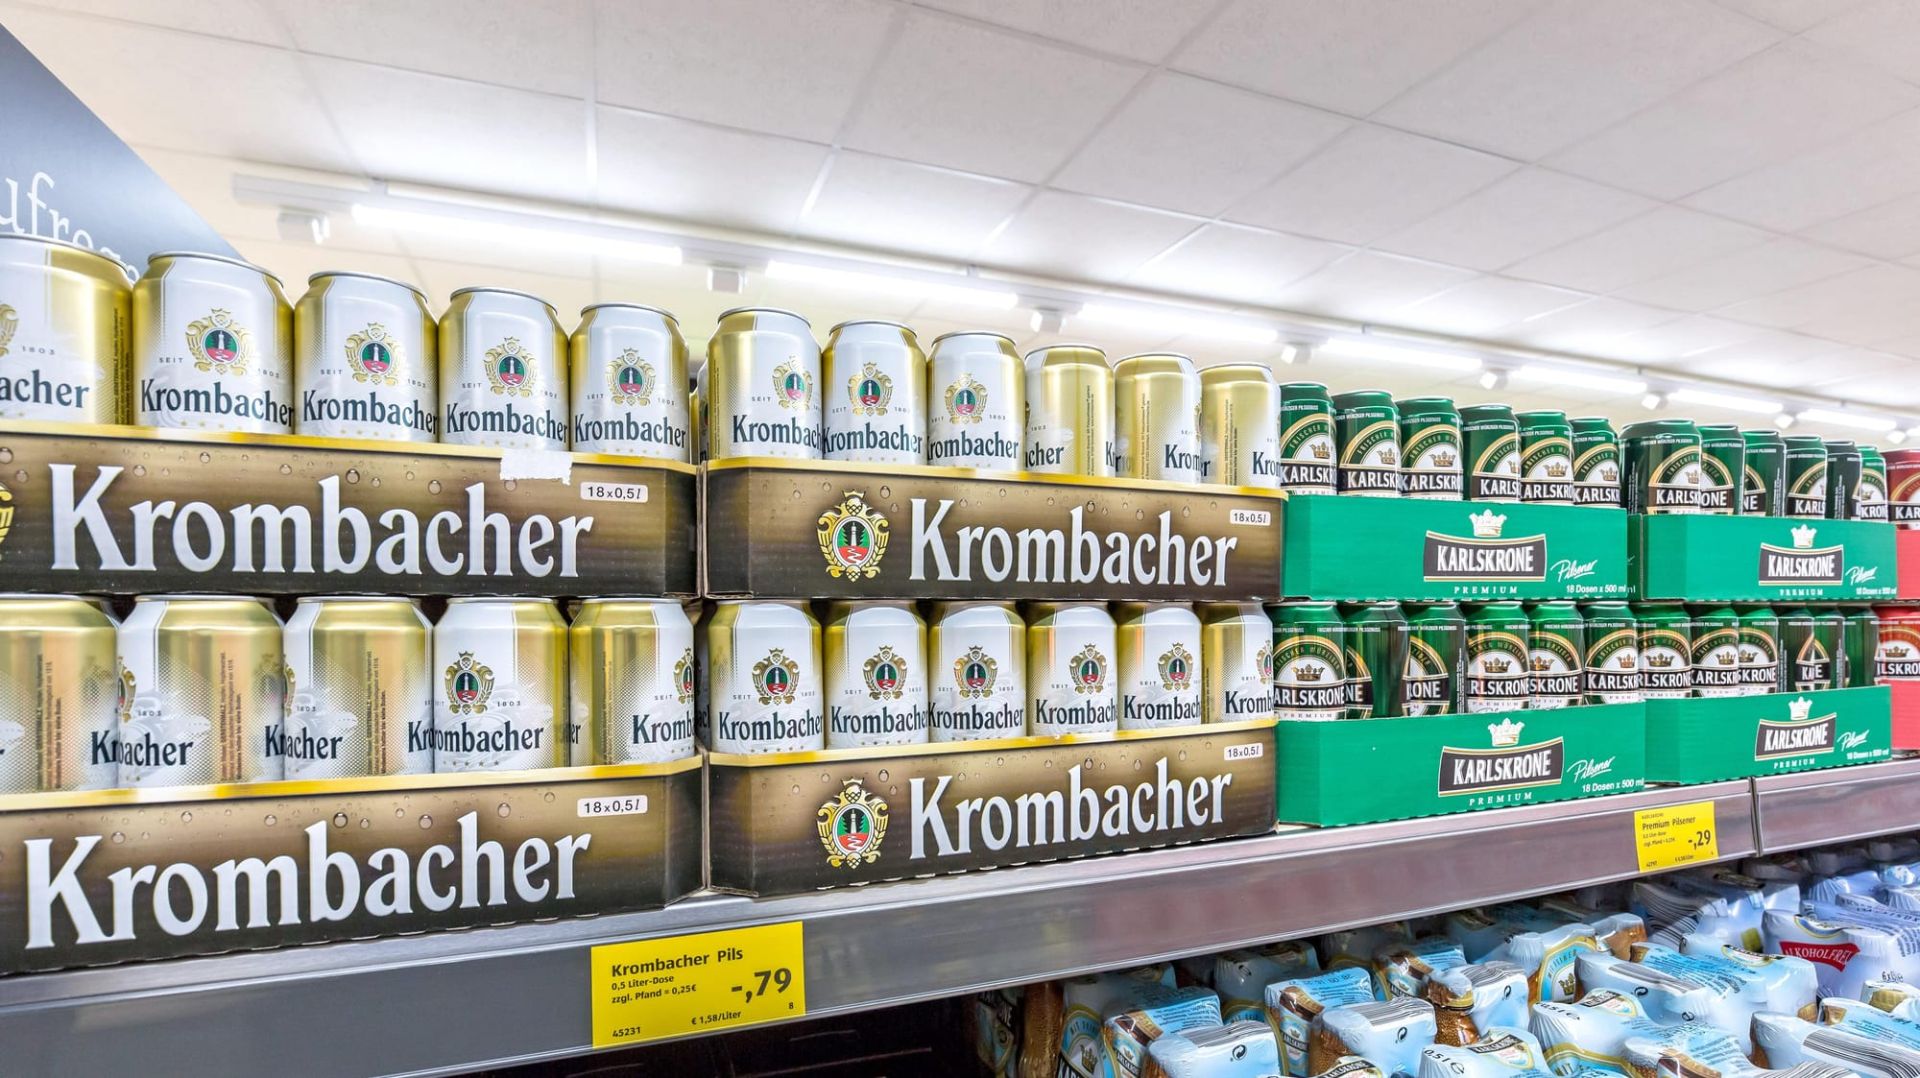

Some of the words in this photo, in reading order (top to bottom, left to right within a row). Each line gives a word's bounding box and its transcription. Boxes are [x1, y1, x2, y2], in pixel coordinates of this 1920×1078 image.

[22, 345, 56, 356] 1803
[140, 378, 294, 428] Krombacher
[303, 390, 439, 435] Krombacher
[831, 406, 847, 414] SEIT
[446, 403, 568, 443] Krombacher
[574, 412, 687, 449] Krombacher
[823, 422, 923, 455] Krombacher
[49, 463, 594, 578] Krombacher
[910, 497, 1239, 587] Krombacher
[1436, 544, 1534, 573] KARLSKRONE
[1768, 555, 1835, 577] KARLSKRONE
[1550, 559, 1598, 583] Pilsener
[1454, 586, 1519, 594] PREMIUM
[1566, 585, 1574, 594] 18
[1780, 588, 1823, 596] PREMIUM
[137, 708, 162, 717] 1803
[296, 705, 317, 713] 1803
[928, 699, 1024, 730] Krombacher
[1764, 723, 1829, 752] KARLSKRONE
[1453, 749, 1552, 785] KARLSKRONE
[1566, 755, 1616, 783] Pilsener
[1773, 758, 1816, 770] PREMIUM
[1582, 784, 1591, 793] 18
[1592, 782, 1614, 792] Dosen
[1622, 779, 1634, 788] 500
[910, 758, 1232, 860] Krombacher
[1468, 791, 1533, 806] PREMIUM
[1642, 820, 1670, 830] Premium
[1672, 816, 1696, 827] Pilsener
[23, 811, 592, 950] Krombacher
[611, 953, 710, 977] Krombacher
[717, 947, 744, 963] Pils
[611, 982, 626, 991] 0,5
[628, 974, 674, 989] Liter-Dose
[611, 994, 632, 1004] zzgl.
[635, 989, 662, 1000] Pfand
[671, 984, 697, 996] 0,25€
[788, 1002, 794, 1010] 8
[691, 1017, 697, 1026] €
[699, 1011, 742, 1025] 1,58/Liter
[612, 1026, 641, 1038] 45231
